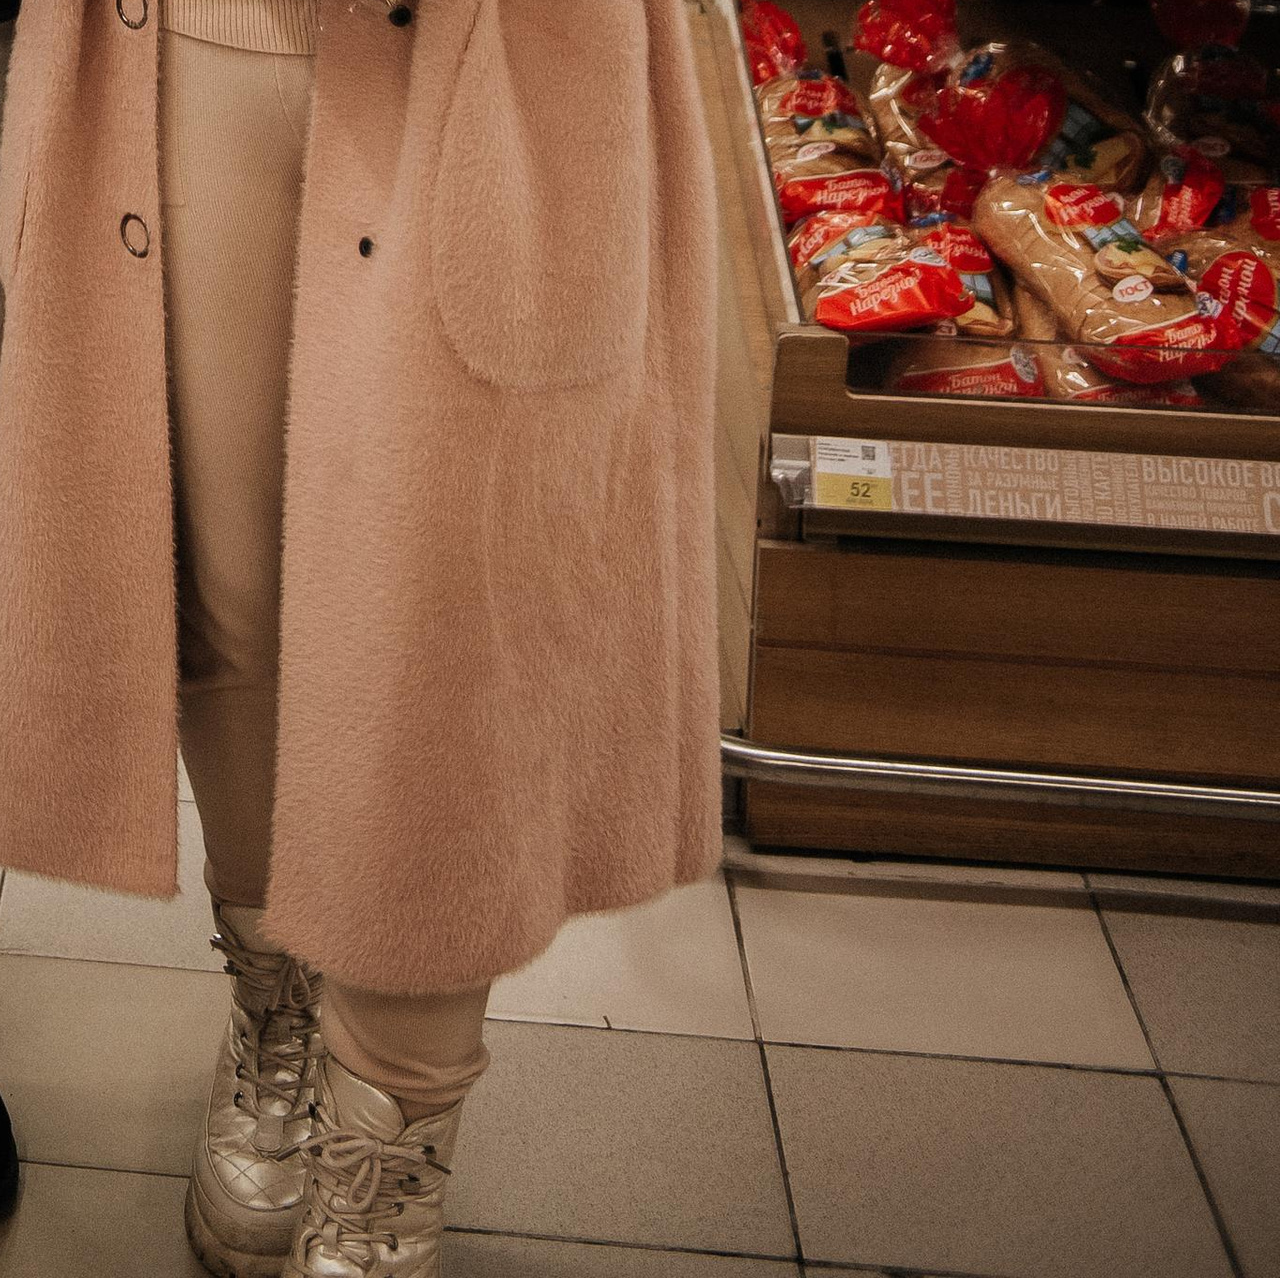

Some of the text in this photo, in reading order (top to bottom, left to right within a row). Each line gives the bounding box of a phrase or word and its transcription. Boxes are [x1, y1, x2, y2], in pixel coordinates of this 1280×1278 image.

[1120, 279, 1151, 298] ГОСТ
[964, 446, 1060, 472] КАЧЕСТВО
[1142, 458, 1256, 488] ВЫСОКОЕ
[850, 482, 871, 498] 52
[1092, 454, 1112, 501] КАРТЕ
[967, 489, 1062, 521] ДЕНЬГИ
